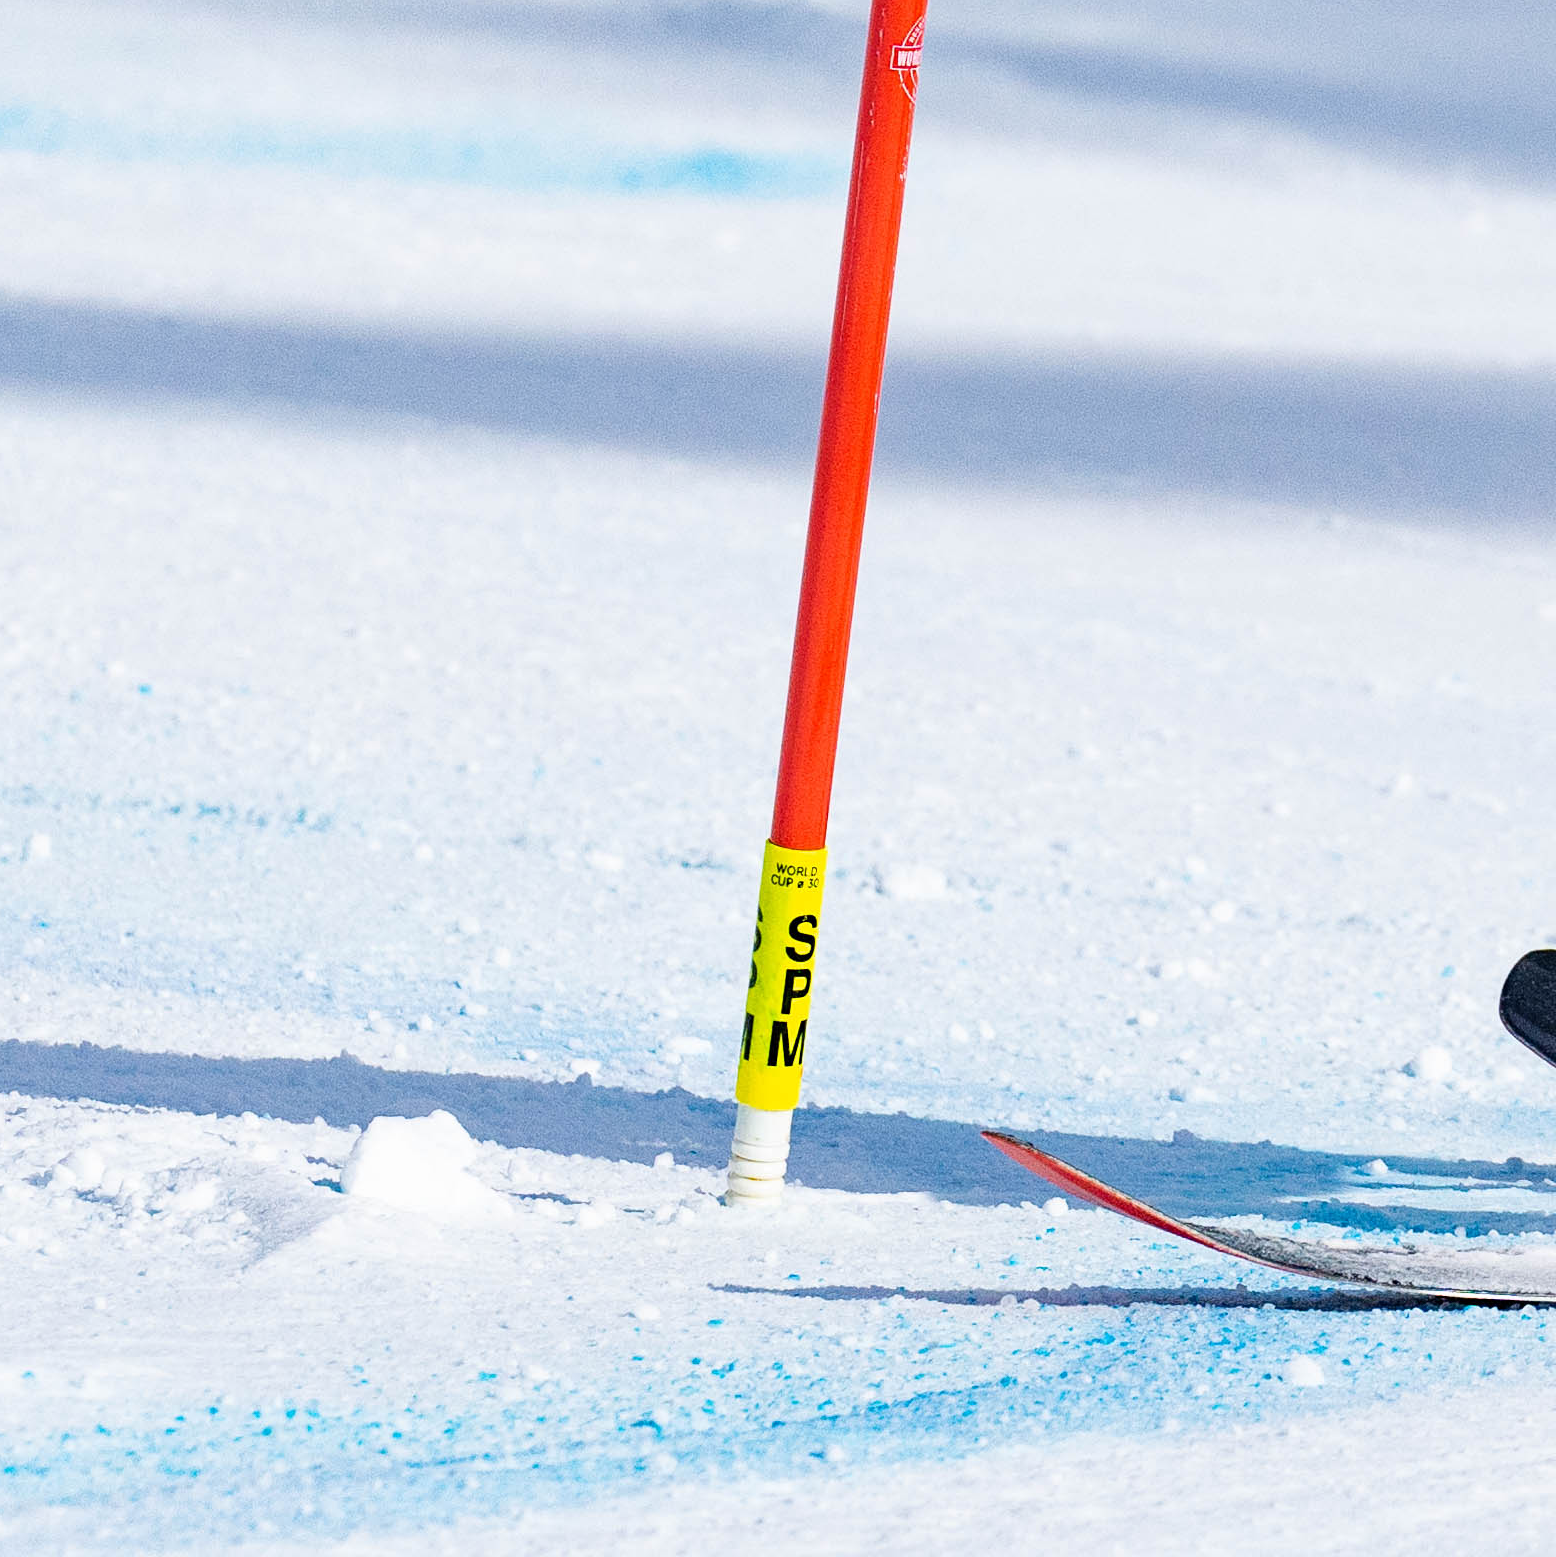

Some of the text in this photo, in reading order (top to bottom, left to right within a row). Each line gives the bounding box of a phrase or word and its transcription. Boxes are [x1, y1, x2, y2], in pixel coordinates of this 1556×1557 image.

[776, 862, 818, 877] WORLD
[771, 874, 794, 888] CUP
[767, 914, 818, 1067] SPM
